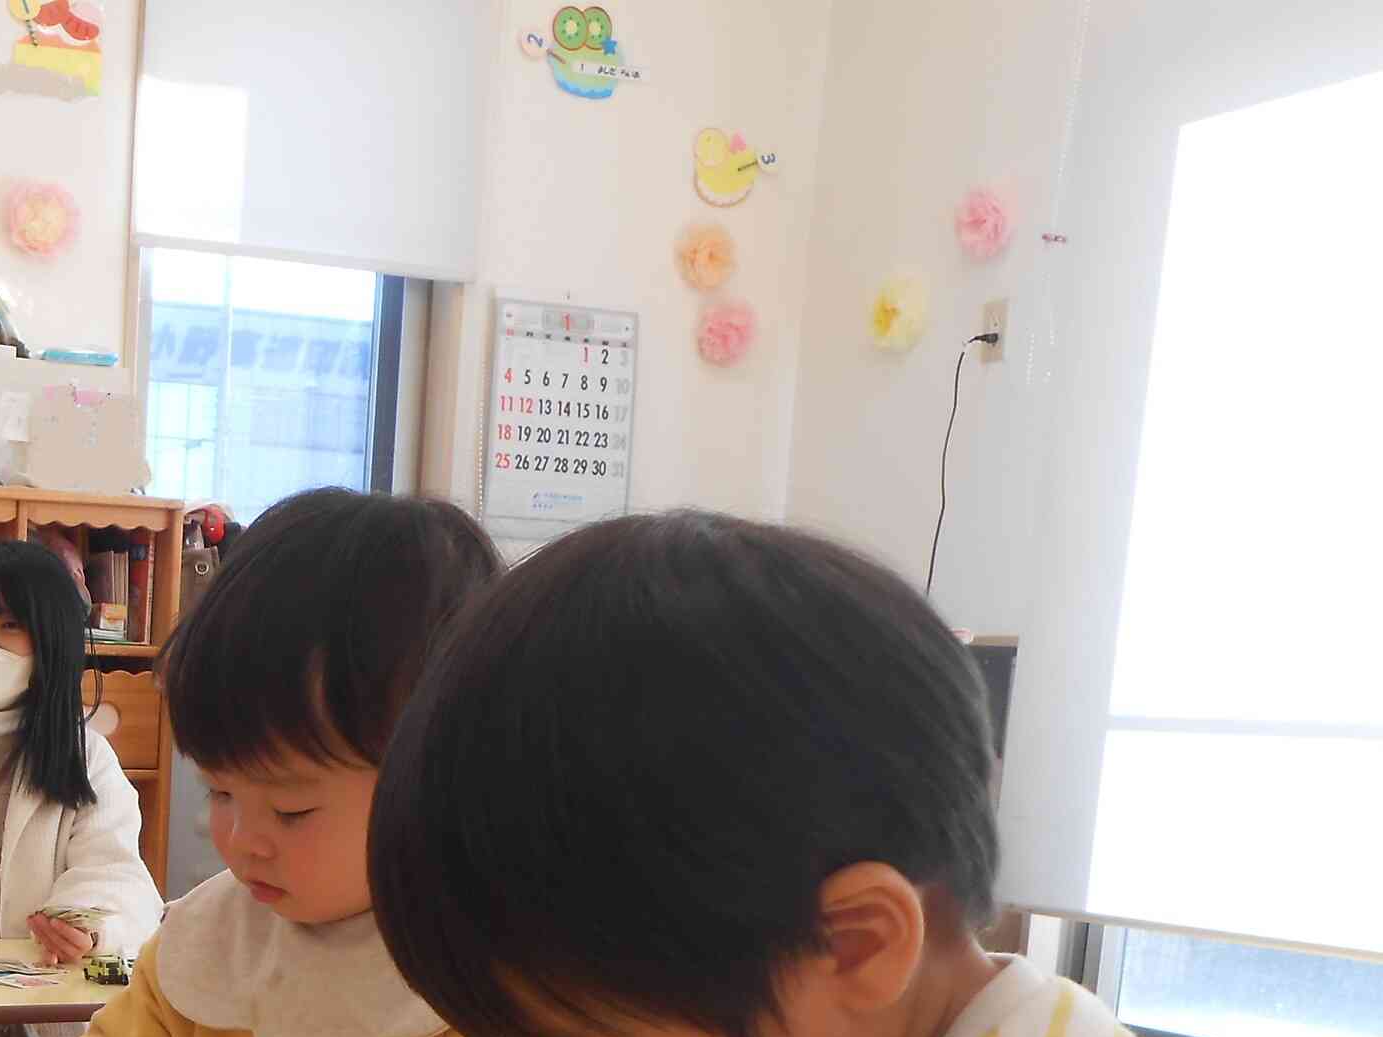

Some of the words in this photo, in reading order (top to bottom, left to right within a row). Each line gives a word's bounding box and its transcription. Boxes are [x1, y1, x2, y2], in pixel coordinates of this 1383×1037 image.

[601, 348, 609, 365] 2
[504, 368, 513, 383] 4
[524, 369, 532, 385] 5
[542, 371, 550, 387] 6
[561, 373, 569, 389] 7
[580, 375, 588, 391] 8
[600, 376, 608, 392] 9
[500, 395, 514, 412] 11
[519, 396, 534, 414] 12
[538, 398, 552, 415] 13
[558, 400, 571, 417] 14
[577, 402, 590, 419] 15
[596, 404, 609, 421] 16
[498, 424, 512, 441] 18
[517, 425, 532, 442] 19
[536, 427, 551, 443] 20
[557, 429, 569, 445] 21
[575, 430, 590, 447] 22
[594, 431, 608, 449] 23
[494, 452, 511, 469] 25
[514, 454, 530, 470] 26
[534, 456, 549, 472] 27
[554, 456, 569, 473] 28
[573, 458, 588, 474] 29
[592, 460, 607, 476] 30
